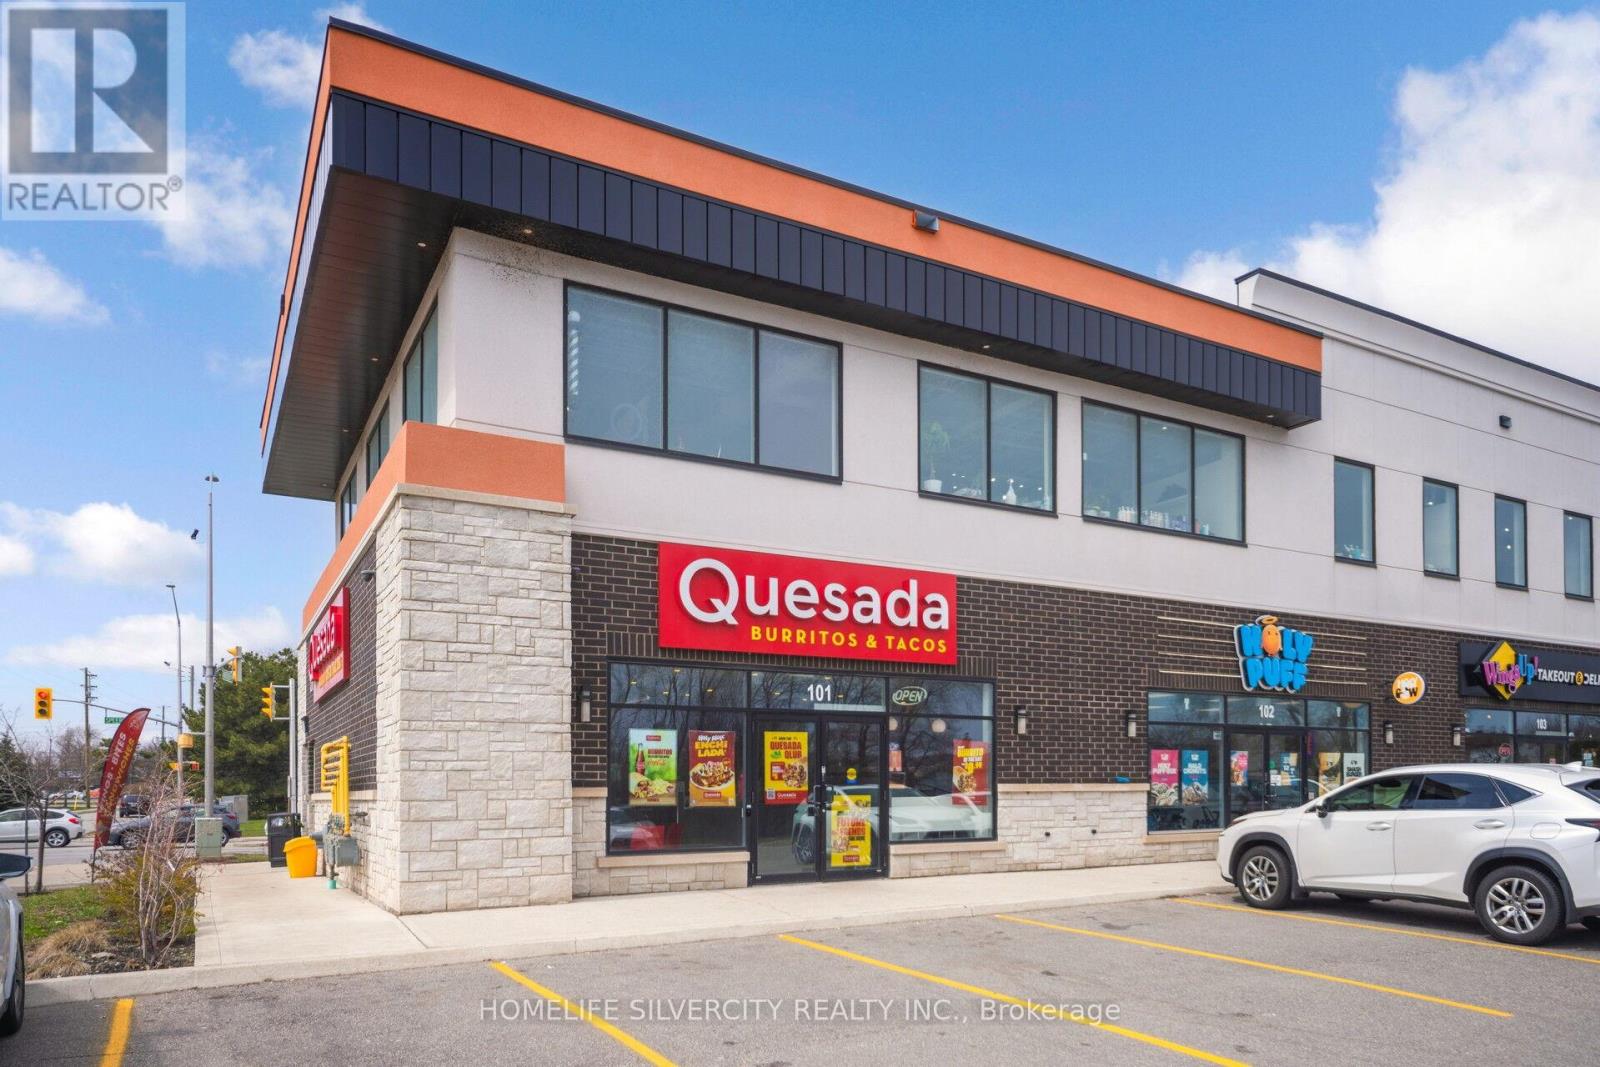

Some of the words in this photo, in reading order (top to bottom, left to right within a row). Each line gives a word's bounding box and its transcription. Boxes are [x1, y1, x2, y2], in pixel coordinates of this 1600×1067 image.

[679, 558, 950, 630] Quesada
[751, 625, 858, 648] BURRITOS
[866, 634, 878, 649] &
[885, 635, 947, 653] TACOS
[1246, 656, 1309, 690] PUFF
[1482, 660, 1520, 694] Wings
[1537, 668, 1575, 684] TAKEOUT
[807, 684, 832, 702] 101
[895, 689, 924, 702] OPEN
[1258, 704, 1275, 719] 102
[1536, 718, 1548, 730] 103
[111, 732, 127, 765] BITES
[770, 741, 802, 750] QUESADA
[104, 738, 136, 815] ANDWICHES
